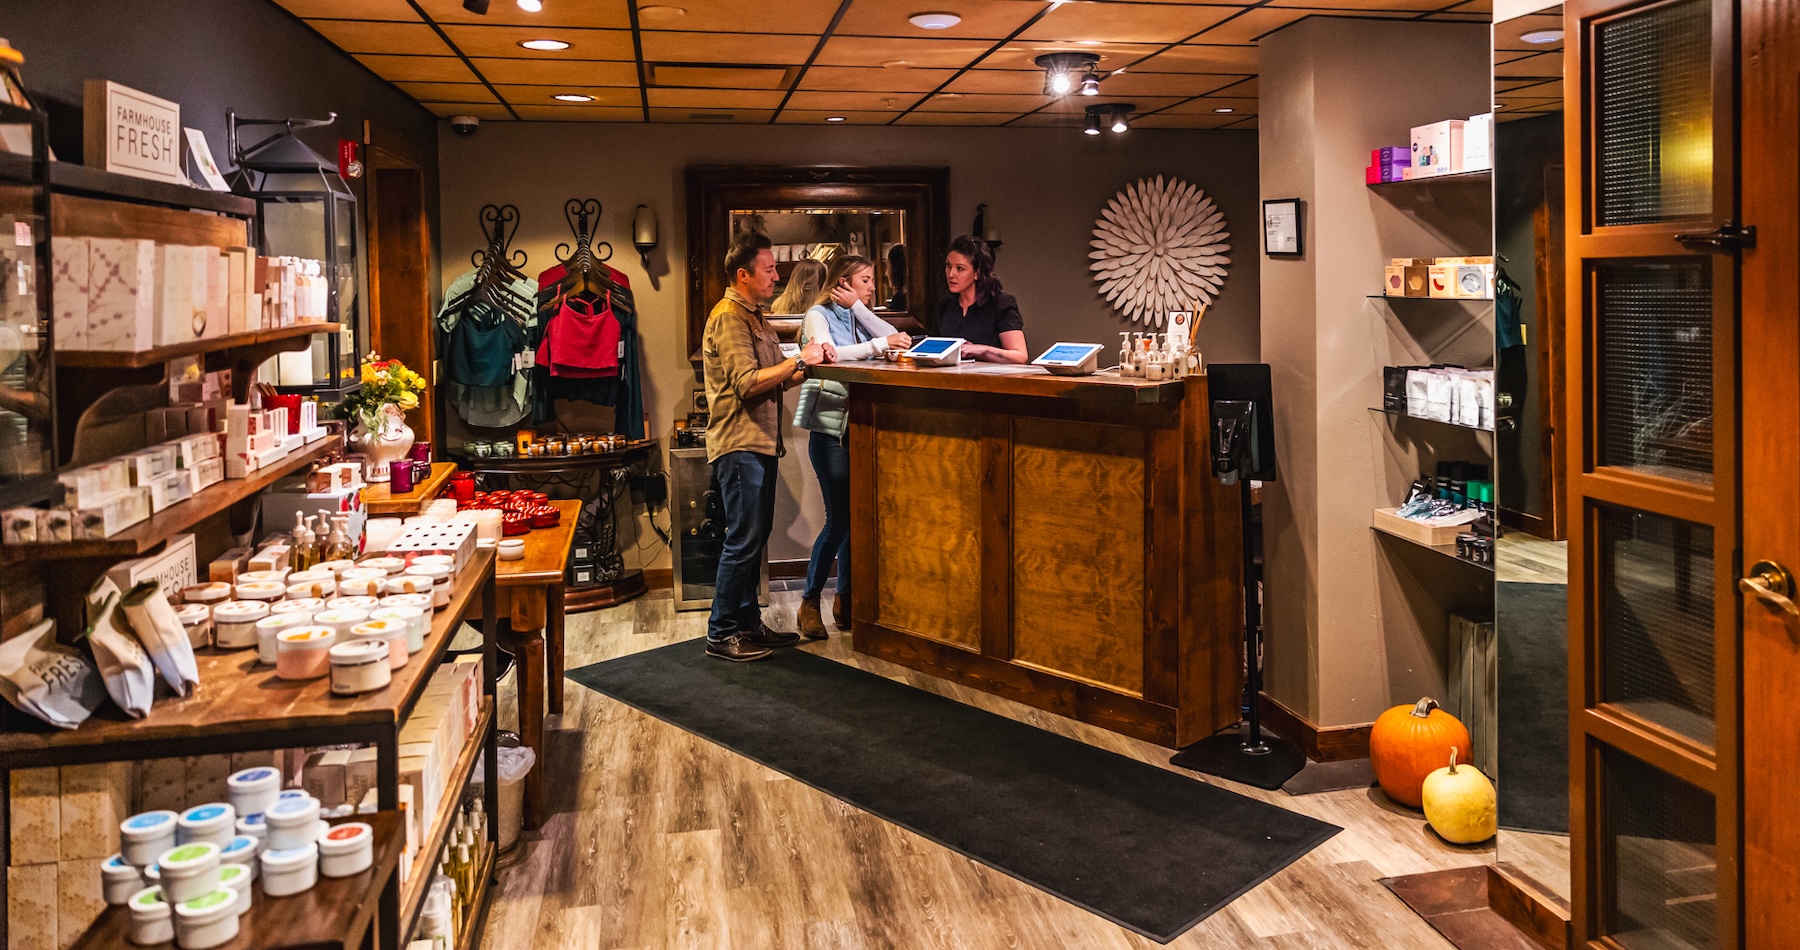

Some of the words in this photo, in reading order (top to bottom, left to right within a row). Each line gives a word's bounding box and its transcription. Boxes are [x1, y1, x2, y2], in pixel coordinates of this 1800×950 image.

[117, 106, 171, 135] FARMHOUSE
[117, 124, 172, 163] FRESH
[156, 556, 189, 587] MHOUSE
[41, 655, 83, 695] FRES
